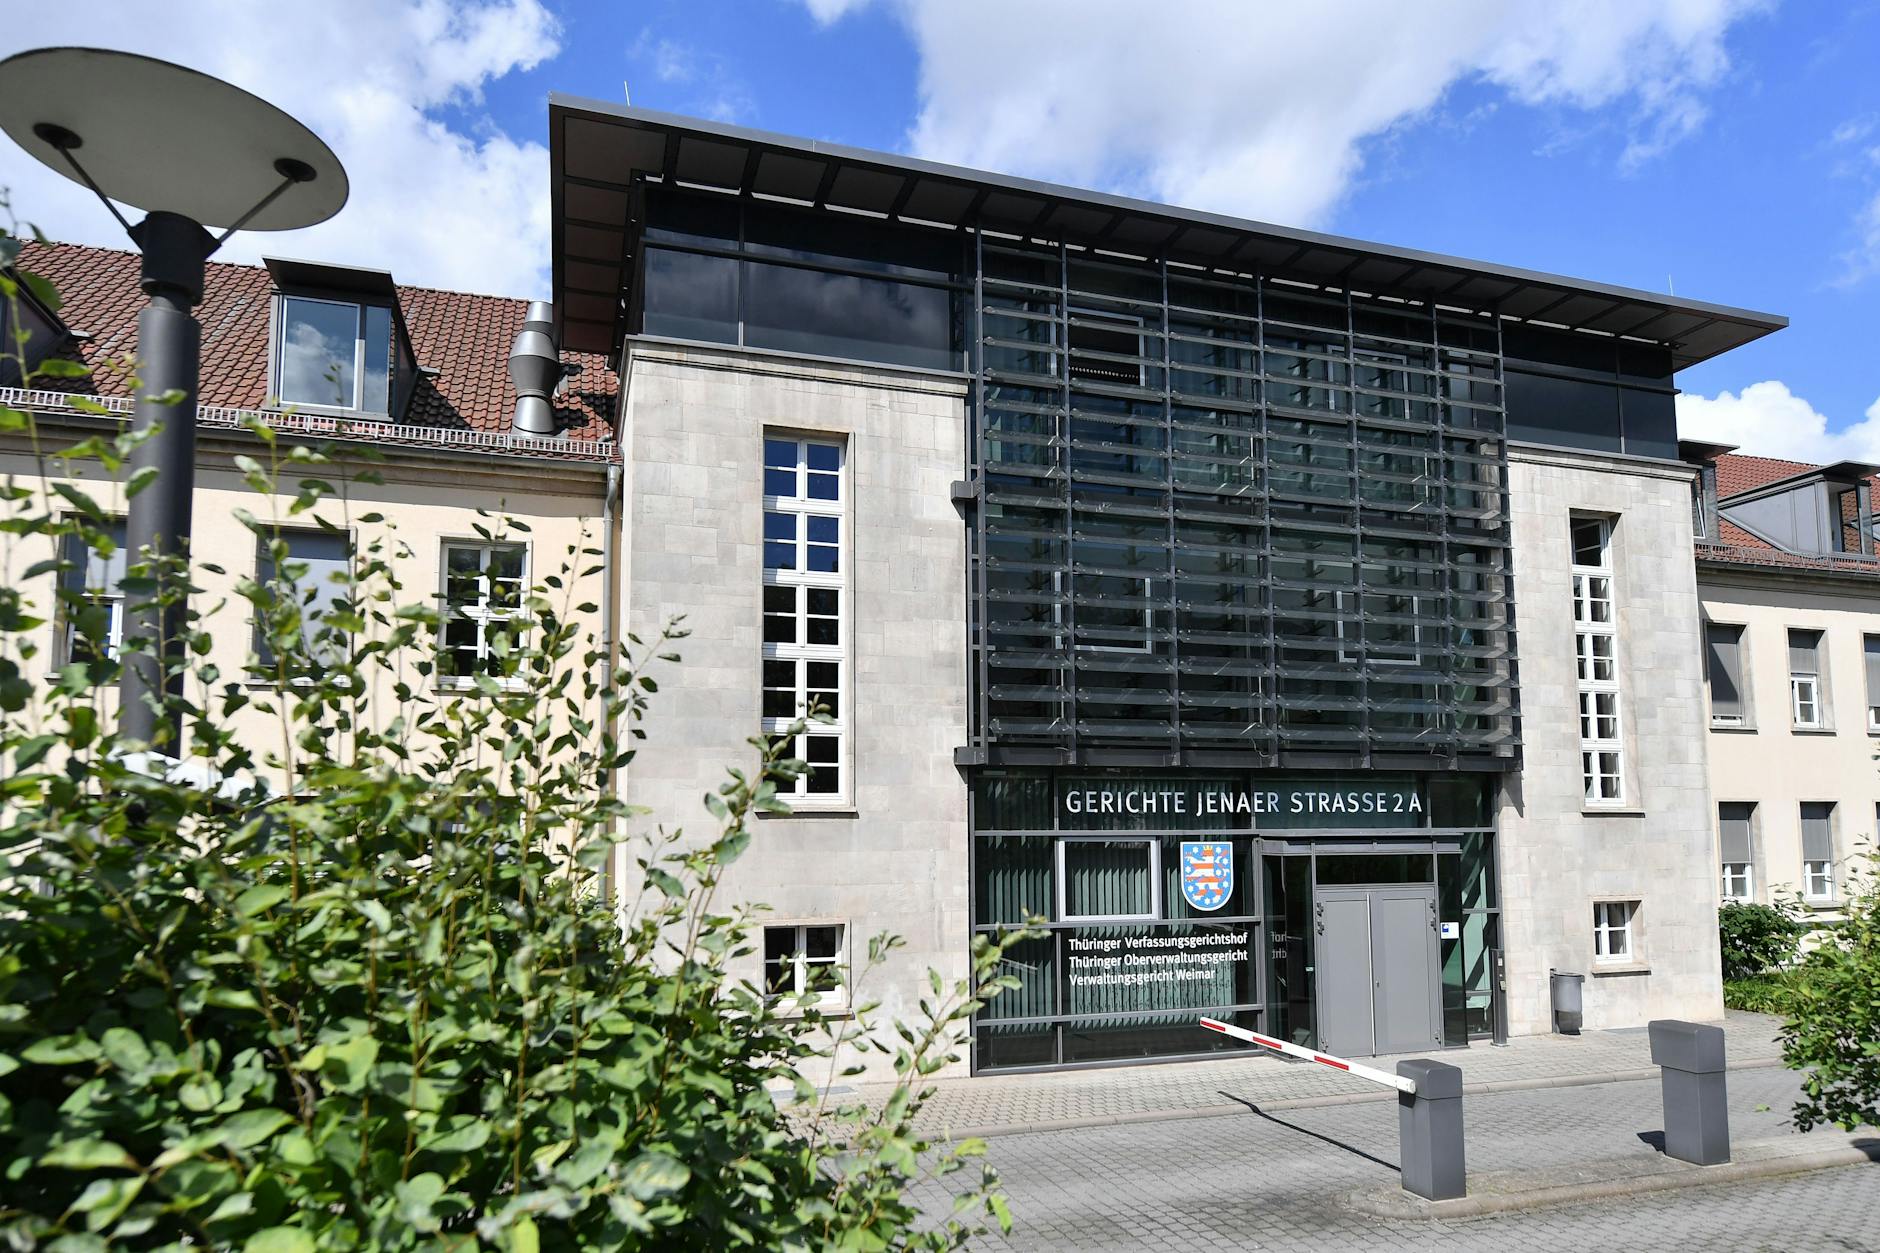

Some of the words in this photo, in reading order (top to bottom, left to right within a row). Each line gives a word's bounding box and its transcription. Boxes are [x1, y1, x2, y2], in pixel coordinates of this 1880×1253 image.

[1065, 790, 1186, 813] GERICHTE
[1196, 791, 1280, 817] JENAER
[1290, 791, 1388, 813] STRASSE
[1068, 938, 1121, 951] Thüringer
[1125, 932, 1248, 949] Verfassungsgerichtshof
[1069, 956, 1121, 969] Thüringer
[1124, 949, 1248, 967] Oberverwaltungsgericht
[1069, 970, 1173, 986] Verwaltungsgericht
[1175, 968, 1215, 981] Weimar
